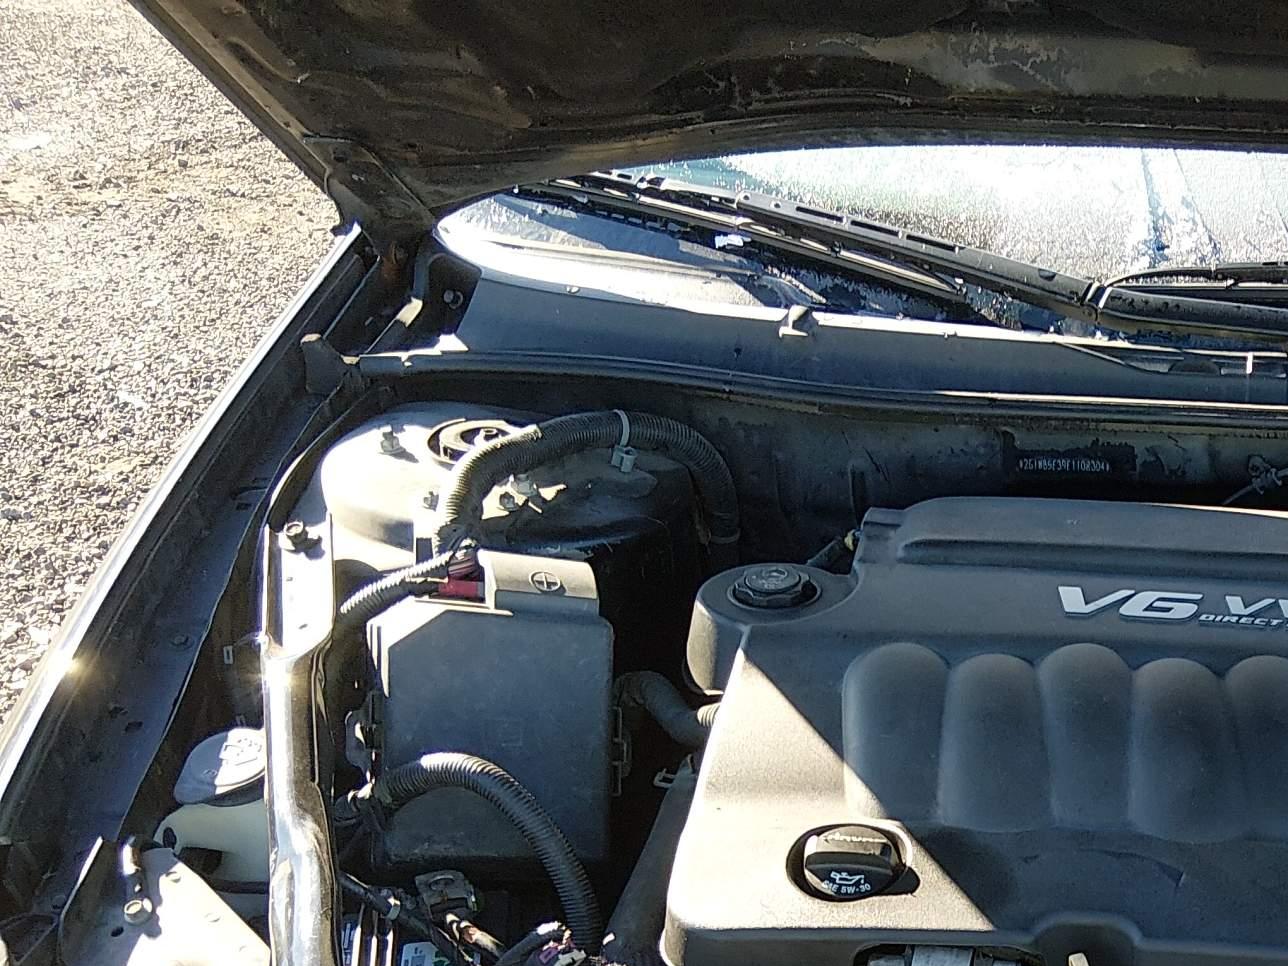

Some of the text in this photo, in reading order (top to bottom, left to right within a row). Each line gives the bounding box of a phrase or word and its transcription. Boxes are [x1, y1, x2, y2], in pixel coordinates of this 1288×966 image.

[1057, 585, 1203, 620] V6
[1199, 614, 1283, 628] DIRECT
[841, 883, 871, 895] 5W-30
